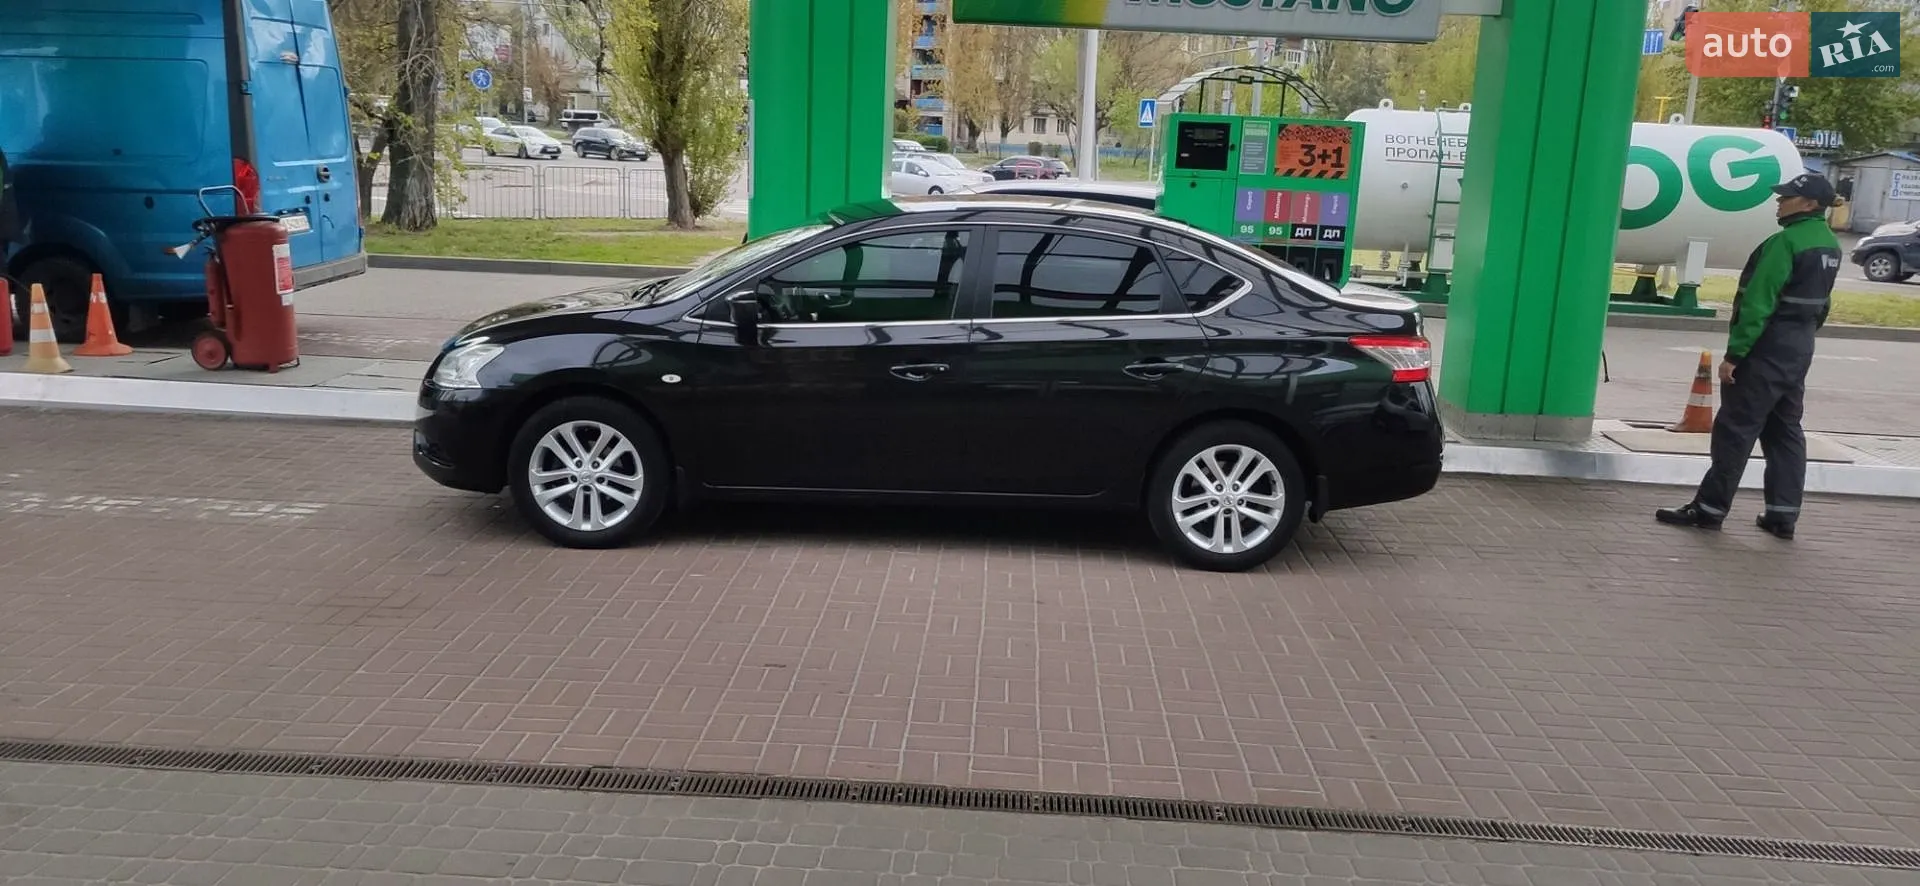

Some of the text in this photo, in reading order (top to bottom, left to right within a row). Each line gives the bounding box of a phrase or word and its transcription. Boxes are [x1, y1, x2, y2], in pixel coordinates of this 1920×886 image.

[1384, 134, 1468, 148] ВОГНЕНЕБ
[1298, 144, 1345, 169] 3+1
[1385, 147, 1466, 161] ПРОПАН-Б
[1620, 135, 1782, 230] OG
[1240, 225, 1254, 234] 95
[1268, 226, 1283, 236] 95
[1295, 227, 1313, 238] ДП
[1323, 229, 1340, 239] ДП
